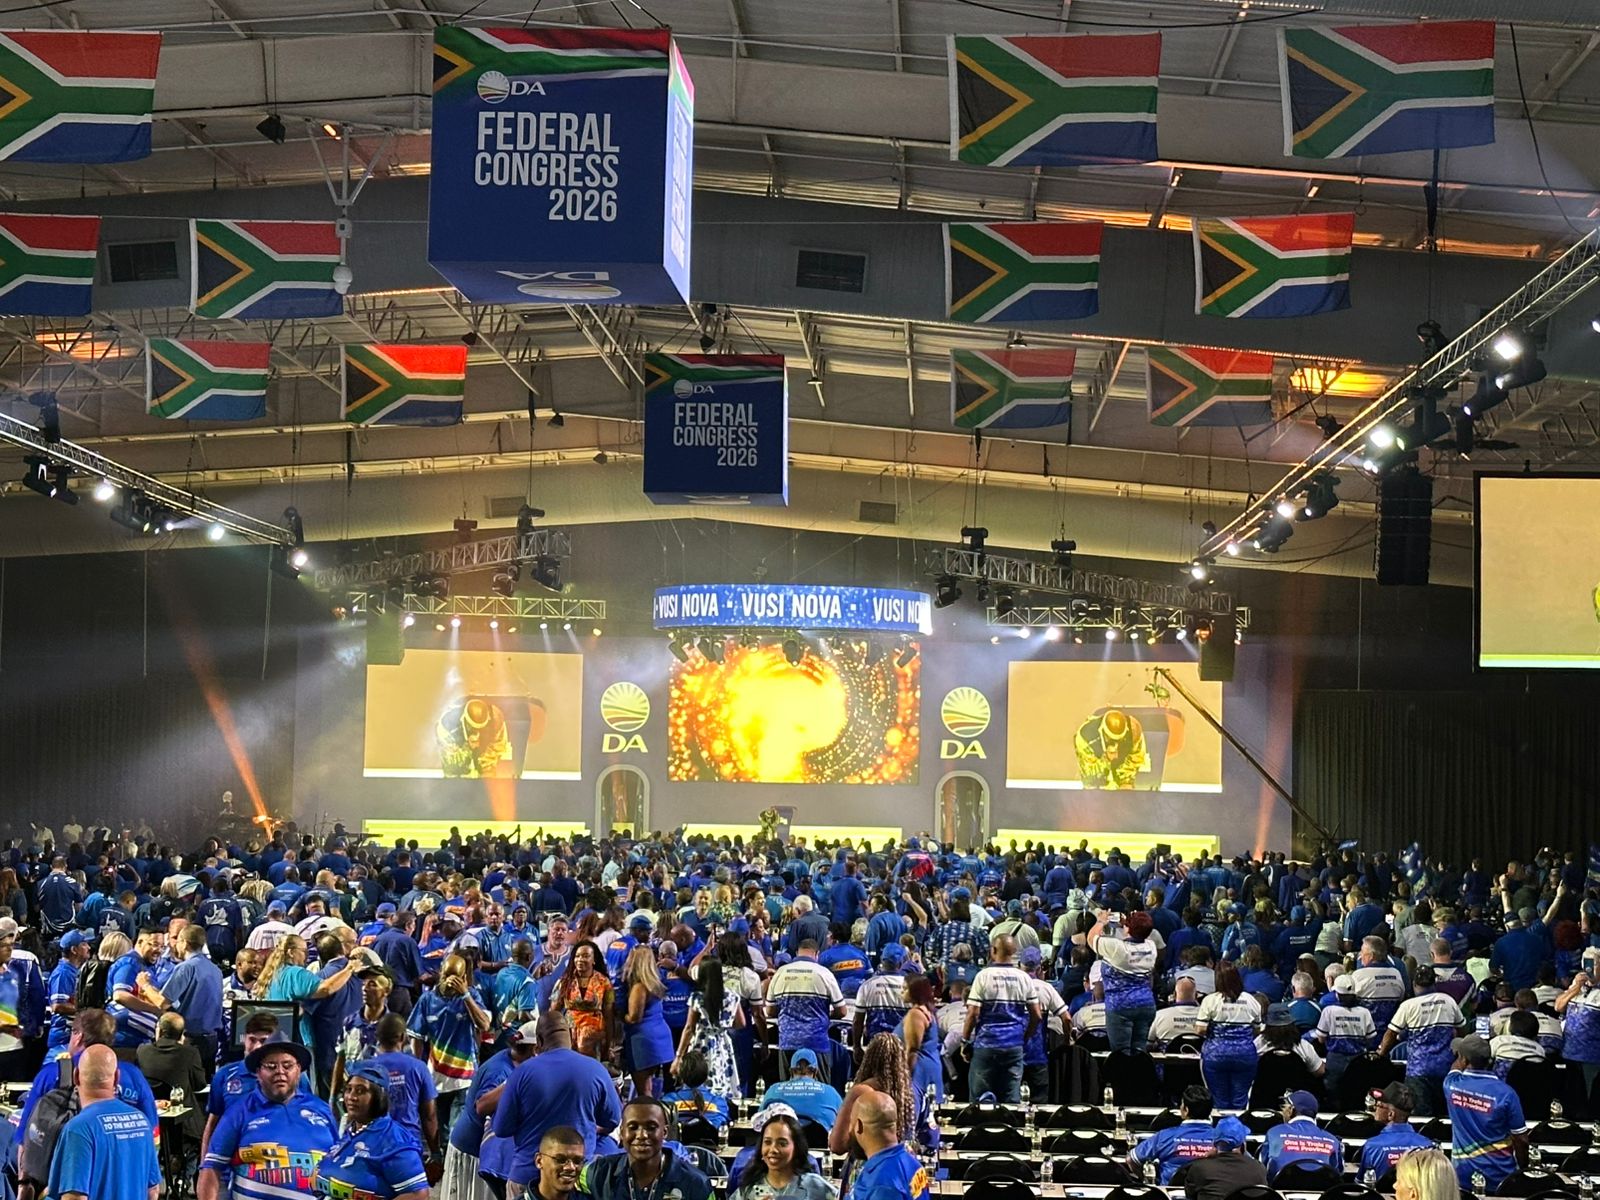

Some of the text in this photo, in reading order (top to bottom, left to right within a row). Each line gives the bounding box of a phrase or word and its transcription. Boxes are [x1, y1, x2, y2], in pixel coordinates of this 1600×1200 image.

[510, 80, 546, 96] DA
[476, 111, 619, 153] FEDERAL
[475, 152, 619, 188] CONGRESS
[548, 188, 618, 222] 2026
[693, 385, 715, 394] DA
[674, 403, 758, 427] FEDERAL
[673, 426, 758, 447] CONGRESS
[717, 447, 758, 467] 2026
[659, 594, 678, 619] VUSI
[681, 592, 719, 618] NOVA
[741, 593, 784, 618] VUSI
[791, 593, 842, 619] NOVA
[872, 596, 905, 624] VUSI
[602, 733, 649, 753] DA
[940, 739, 987, 759] DA
[123, 1087, 139, 1100] DA
